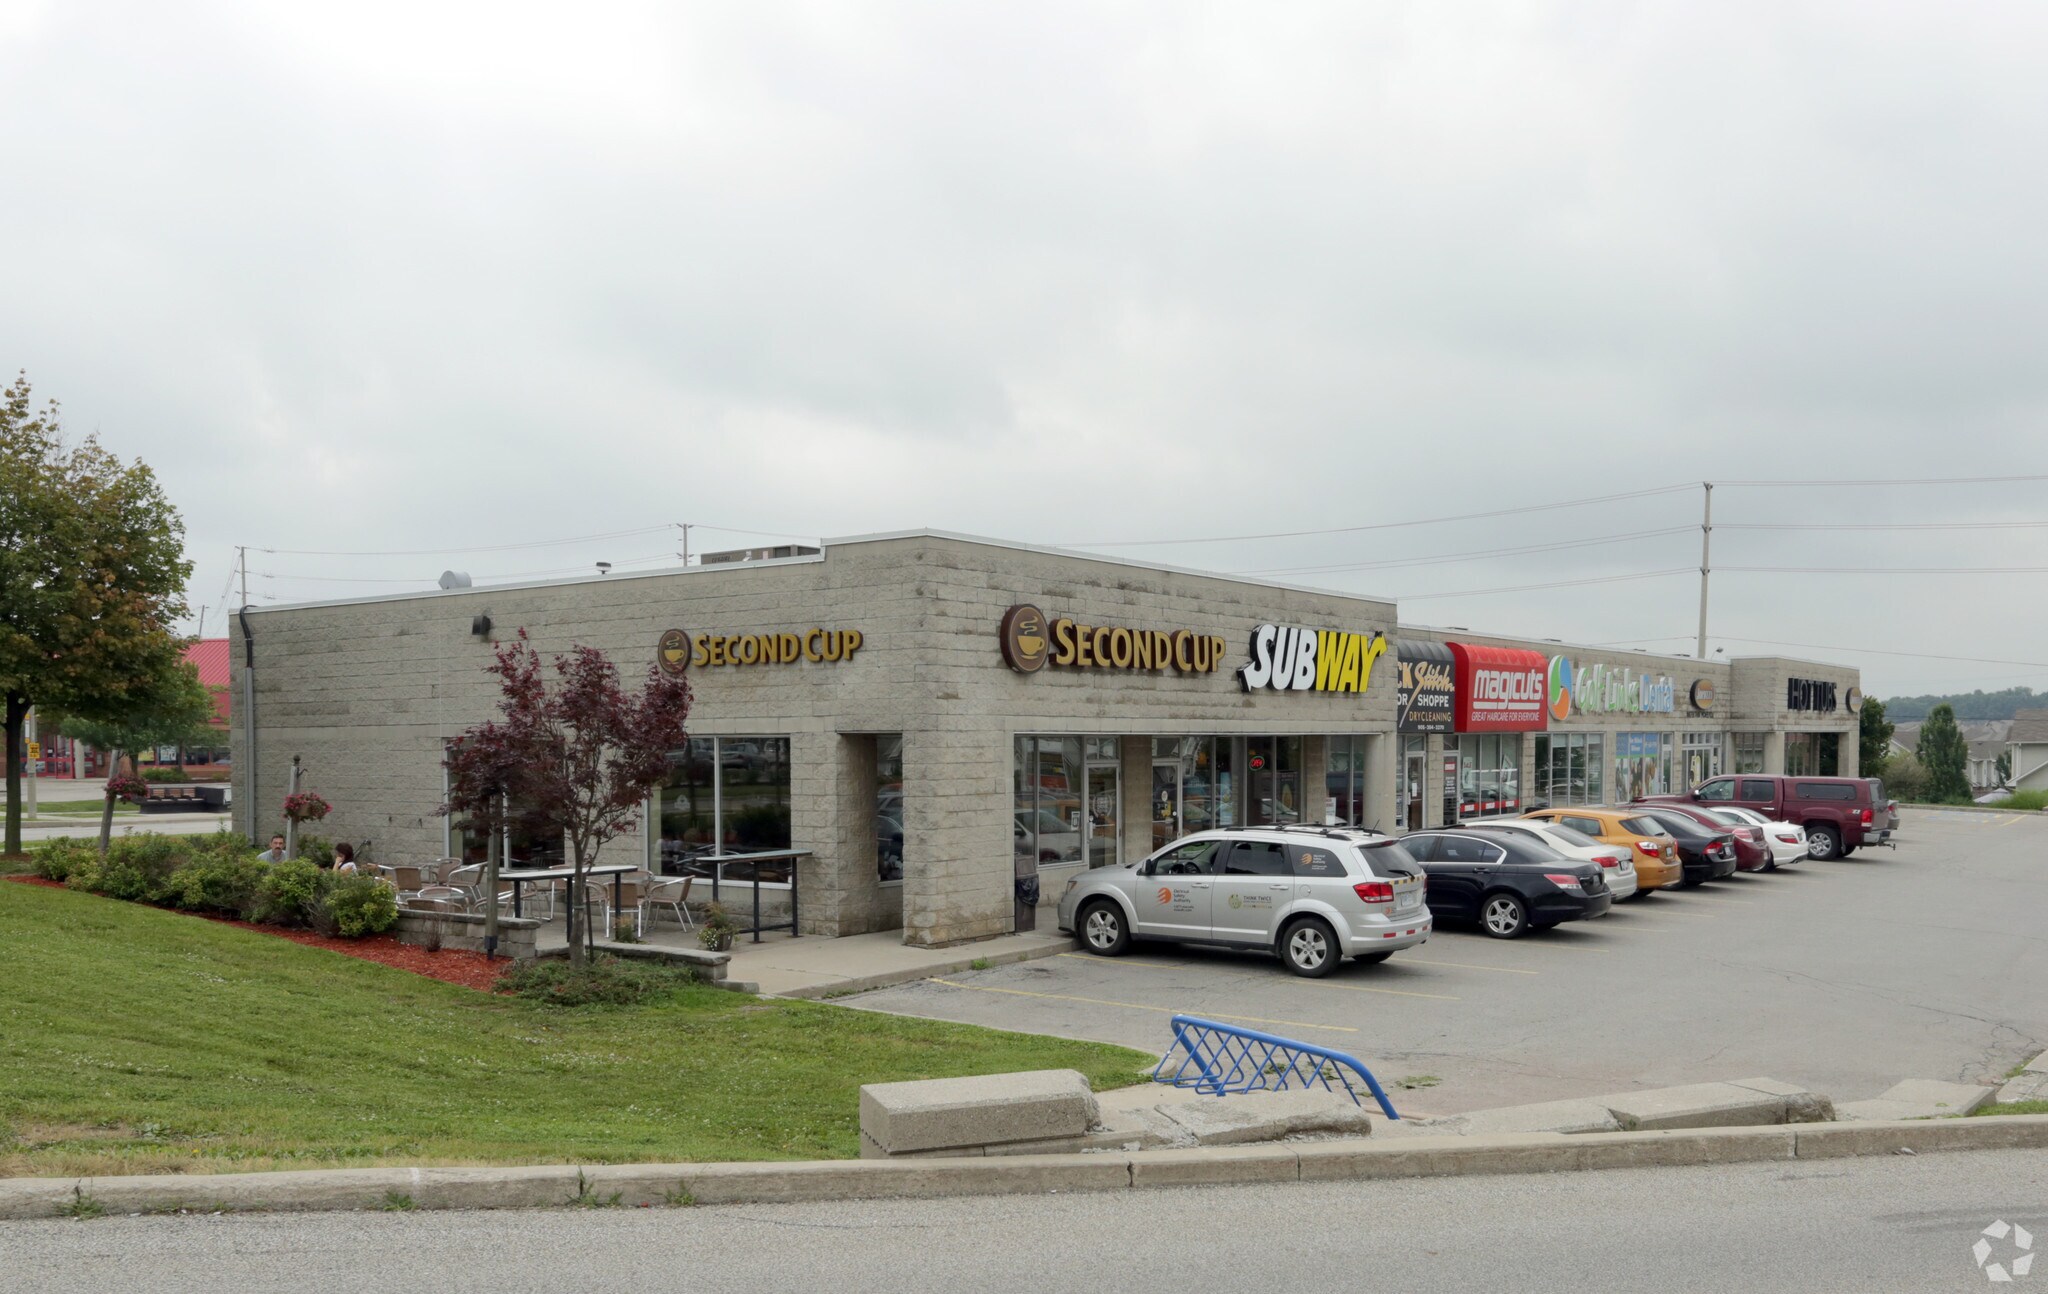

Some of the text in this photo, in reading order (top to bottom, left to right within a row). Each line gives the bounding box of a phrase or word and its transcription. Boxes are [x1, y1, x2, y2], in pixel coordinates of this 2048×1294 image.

[693, 627, 864, 667] SECOND CUP
[1050, 618, 1227, 673] SECOND CUP
[1238, 623, 1388, 693] SUBWAY
[1417, 694, 1450, 708] SHOPPE
[1473, 669, 1544, 710] magicuts
[1788, 678, 1837, 712] HOT TUBS
[1409, 711, 1452, 722] DRYCLEANING
[1471, 711, 1540, 722] GREAT HAIRCARE FOR EVERYONE
